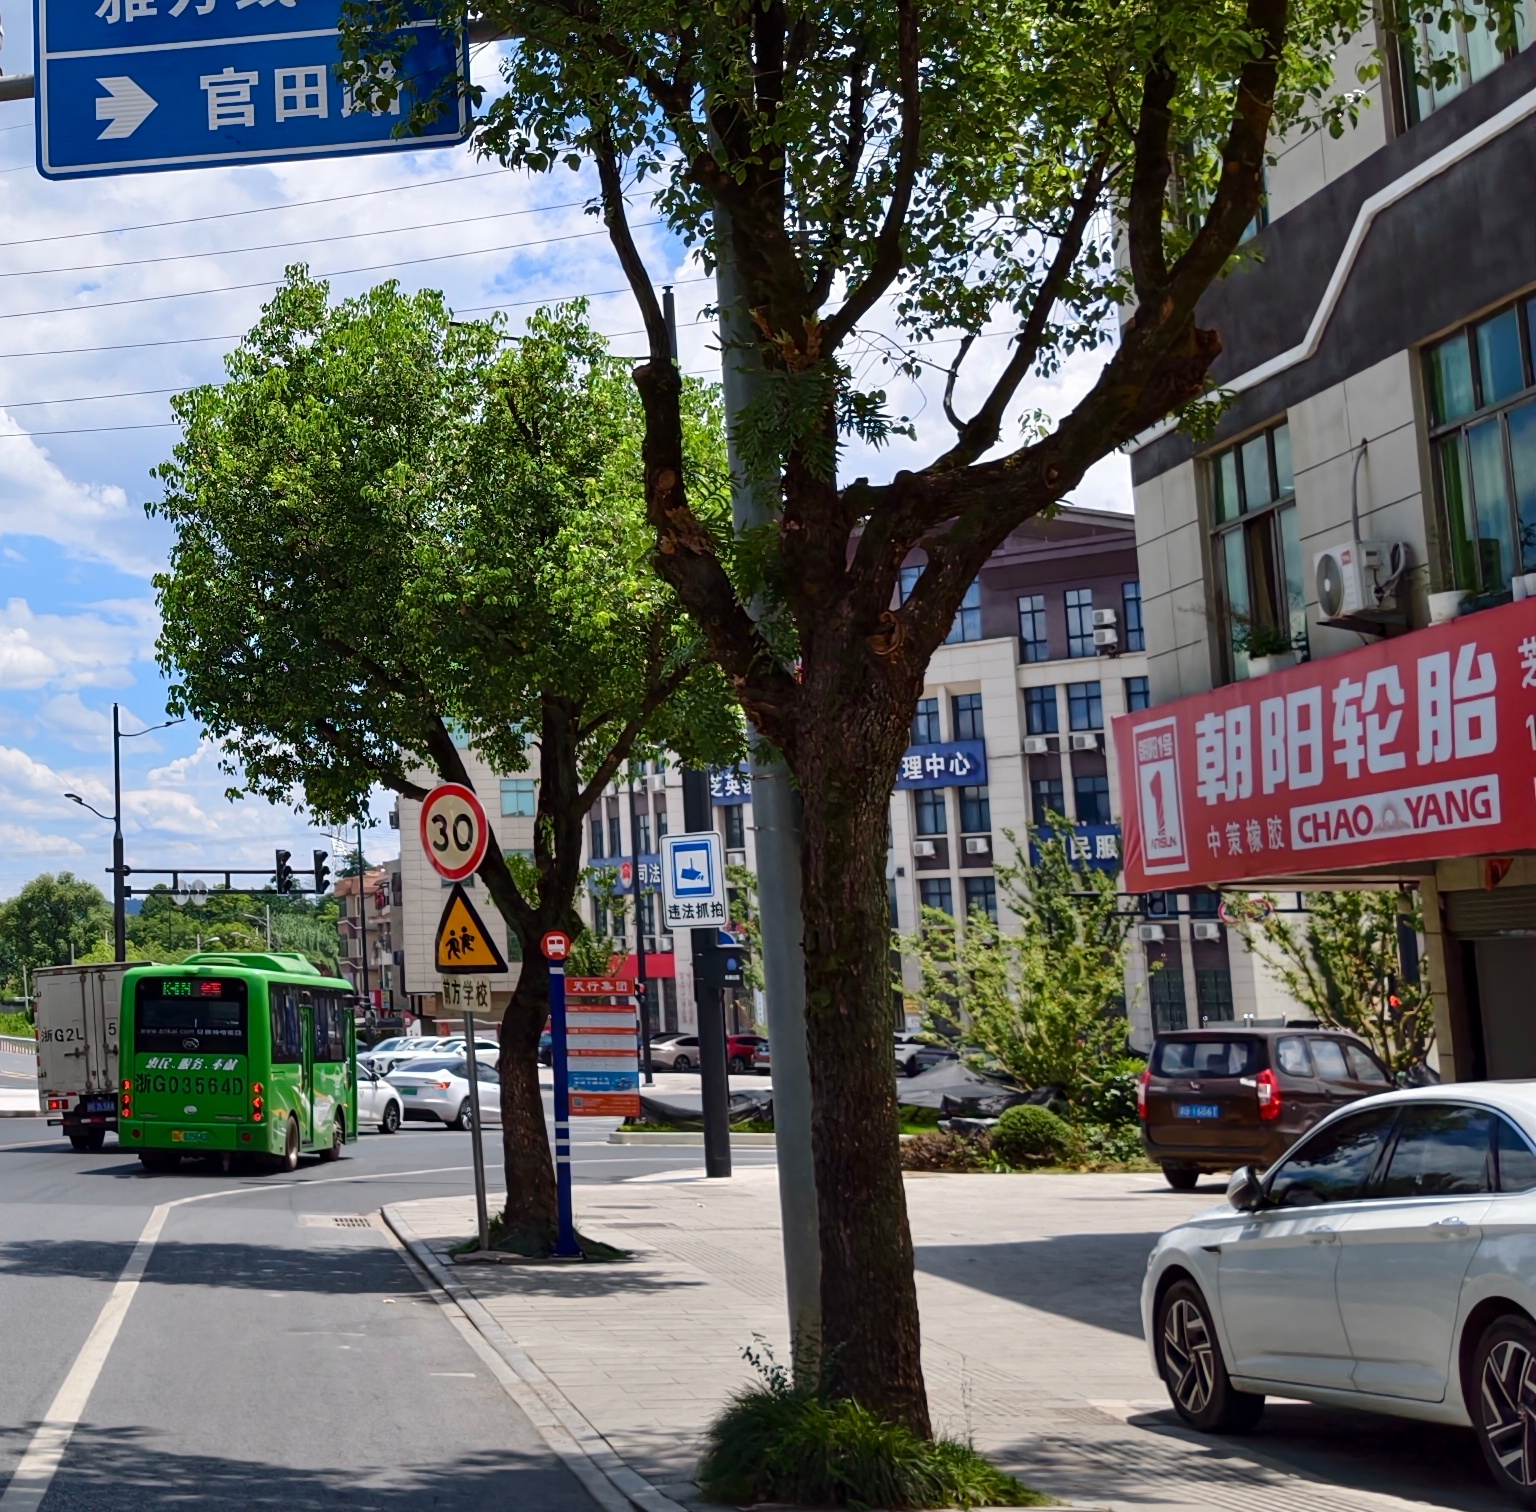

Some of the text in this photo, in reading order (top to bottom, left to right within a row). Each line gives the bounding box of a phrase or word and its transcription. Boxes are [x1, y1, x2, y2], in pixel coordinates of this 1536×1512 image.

[1195, 642, 1498, 806] 朝阳轮胎
[897, 752, 971, 781] 理中心
[1298, 786, 1493, 844] CHAO YANG
[431, 813, 474, 852] 30
[1207, 815, 1286, 859] 中策橡胶
[1052, 835, 1119, 861] 民服
[638, 863, 661, 884] 司法
[667, 902, 724, 920] 违法抓拍
[443, 978, 489, 1008] 前方学校
[572, 981, 628, 992] 天行集团
[135, 1072, 244, 1096] 浙G03564D
